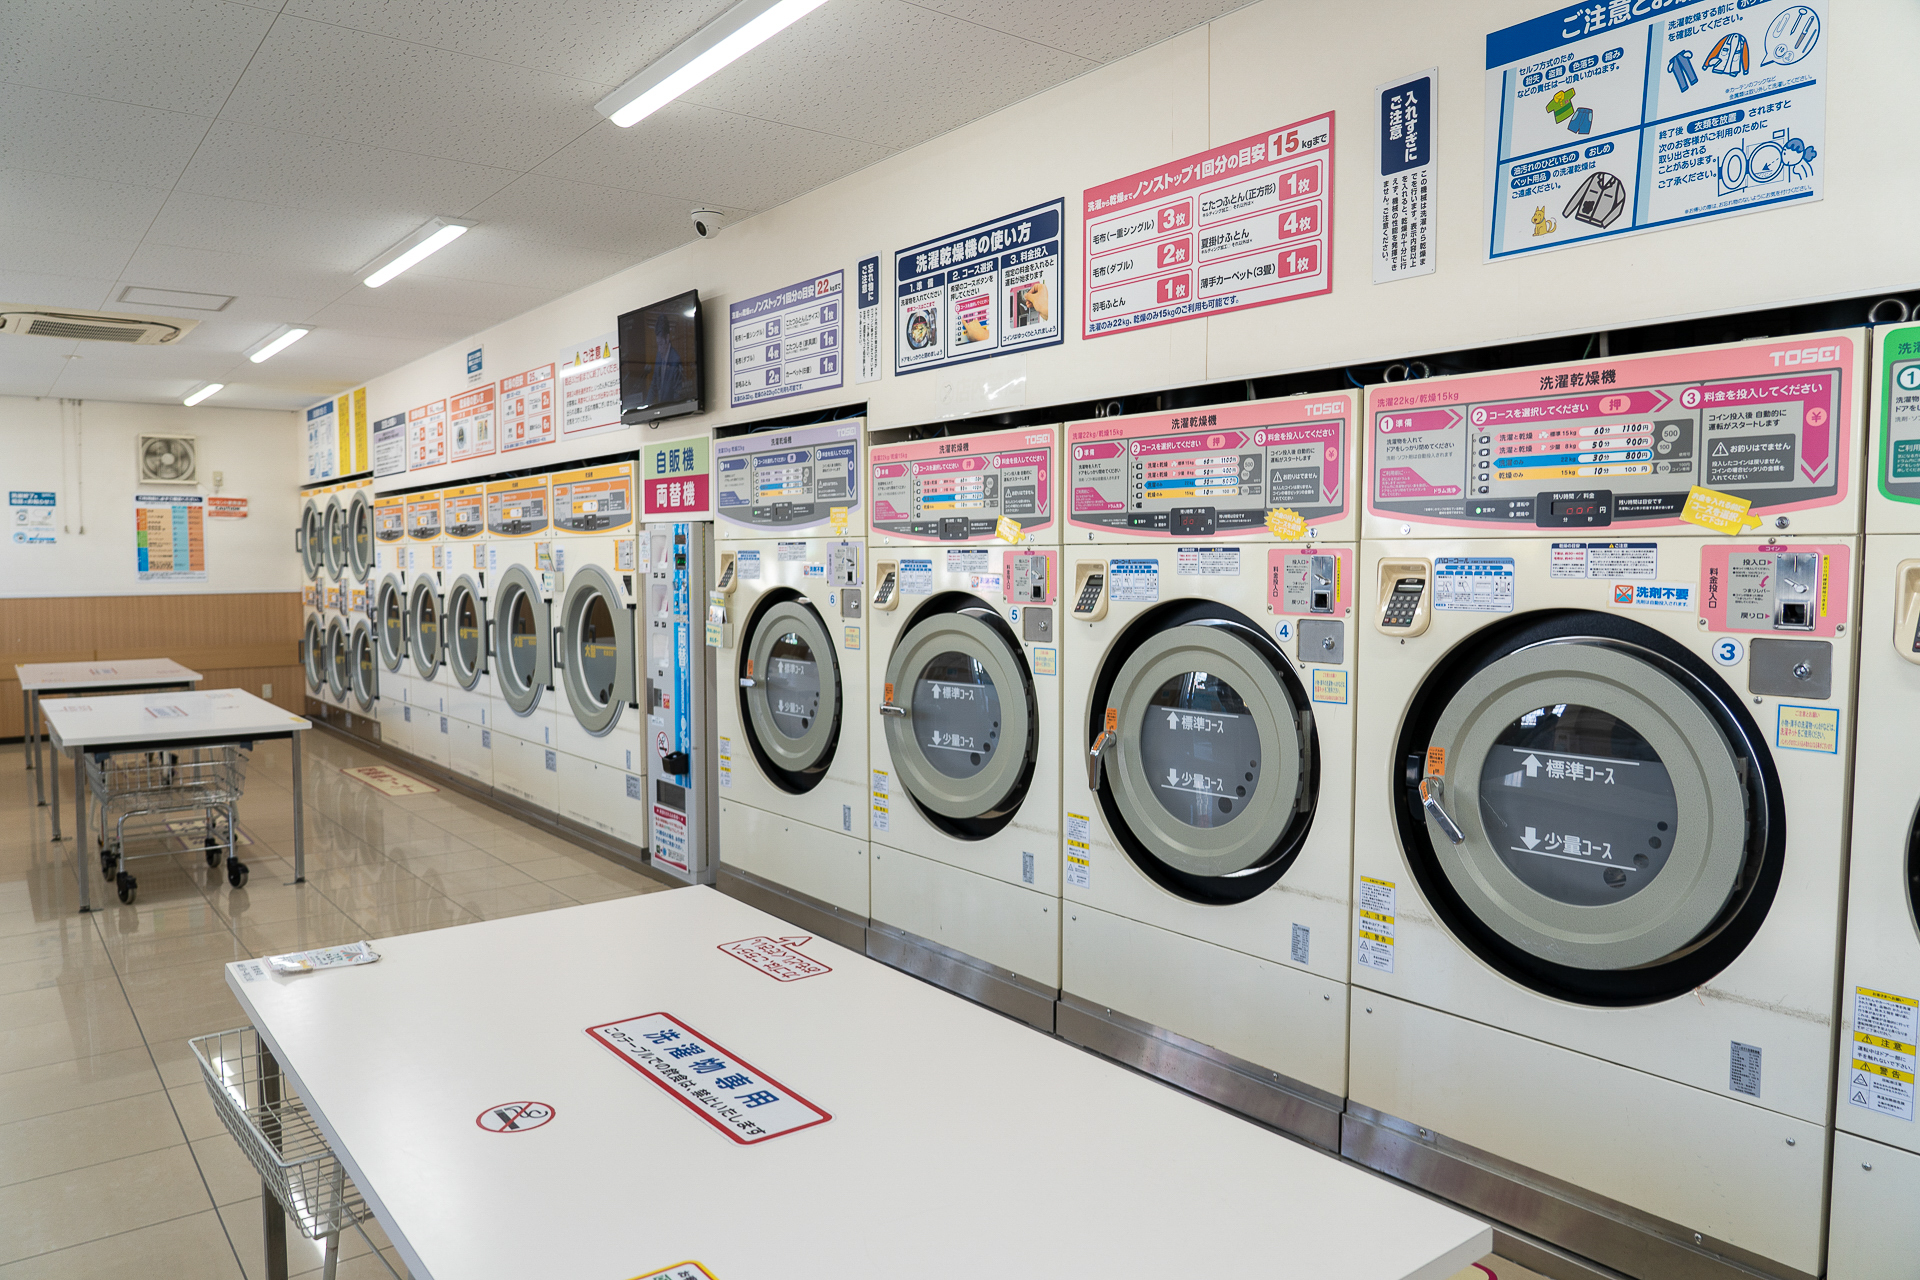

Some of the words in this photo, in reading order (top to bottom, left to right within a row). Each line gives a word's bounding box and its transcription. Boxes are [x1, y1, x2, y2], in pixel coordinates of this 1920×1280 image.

[1668, 3, 1734, 30] 洗濯乾燥する前に
[1668, 15, 1744, 41] を確認してください。
[1519, 52, 1574, 75] セルフ方式のため
[1525, 75, 1540, 86] 紛失
[1548, 67, 1563, 79] 盗難
[1572, 56, 1595, 71] 色落ち
[1606, 51, 1621, 62] 縮み
[1517, 64, 1620, 98] などの責任は一切負いかねます。
[1390, 95, 1402, 140] ご注意
[1659, 126, 1683, 140] 終了後
[1694, 113, 1736, 132] 衣類を放置
[1749, 100, 1791, 118] されますと
[1405, 91, 1418, 162] 入れすぎに
[1272, 131, 1299, 156] 15
[1302, 133, 1327, 149] kgまで
[1659, 120, 1767, 153] 次のお客様がご利用のために
[1513, 153, 1576, 176] 油汚れのひどいもの
[1588, 144, 1611, 156] おしめ
[1659, 145, 1706, 164] 取り出される
[1659, 156, 1716, 174] ことがあります。
[1513, 173, 1547, 186] ペット用品
[1553, 161, 1596, 178] の洗濯乾燥は
[1658, 170, 1716, 189] ご了承ください。
[1202, 183, 1276, 212] こたつふとん（正方形）
[1287, 174, 1310, 195] 1枚
[1511, 183, 1561, 199] ご遠慮ください。
[1163, 209, 1185, 229] 3枚
[1201, 229, 1249, 250] 夏掛けふとん
[1283, 212, 1311, 234] 4枚
[916, 222, 1031, 273] 洗濯乾燥機の使い方
[1020, 246, 1048, 261] 料金投入
[1005, 259, 1055, 278] 指定の料金を入れると
[1093, 260, 1133, 277] 毛布（ダブル）
[1163, 244, 1185, 265] 2枚
[1287, 252, 1308, 273] 1枚
[962, 261, 993, 278] コース選択
[951, 275, 993, 292] 希望のコースボタンを
[1005, 270, 1044, 287] 運転が始まります
[817, 279, 829, 295] 22
[951, 287, 980, 301] 押してください
[901, 290, 942, 306] 洗濯物を入れてください
[1093, 298, 1125, 313] 羽毛ふとん
[1165, 280, 1185, 298] 1枚
[824, 307, 834, 321] 1枚
[768, 322, 779, 335] 5枚
[824, 332, 834, 346] 1枚
[583, 346, 601, 363] ご注意
[768, 346, 779, 359] 4枚
[1769, 345, 1840, 366] TOSEI
[823, 358, 833, 372] 1枚
[768, 371, 779, 384] 2枚
[1540, 369, 1616, 391] 洗濯乾燥機
[1377, 392, 1459, 408] 洗濯22kg/乾燥15kg
[1704, 383, 1823, 402] 料金を投入してください
[1305, 402, 1344, 416] TOSEI
[1490, 403, 1589, 420] コースを選択してください
[1609, 398, 1622, 410] 押
[1709, 411, 1752, 422] コイン投入後
[1756, 409, 1787, 418] 自動的に
[1172, 415, 1217, 430] 洗濯乾燥機
[1396, 420, 1412, 428] 準備
[1709, 419, 1780, 431] 運転がスタートします
[837, 427, 856, 437] TOSEI
[1025, 434, 1050, 445] TOSEI
[1268, 429, 1335, 441] 料金を投入してください
[1499, 432, 1533, 441] 洗濯と乾燥
[1594, 427, 1610, 435] 60分
[1664, 429, 1678, 438] 500
[939, 443, 969, 454] 洗濯乾燥機
[1141, 440, 1201, 451] コースを選択してください
[1386, 436, 1423, 445] 洗濯物を入れて
[1386, 442, 1455, 453] ドアをしっかり閉めてください
[1499, 444, 1533, 454] 洗濯と乾燥
[1592, 440, 1610, 449] 50分
[1626, 438, 1649, 447] 900円
[1730, 443, 1791, 453] お釣りはでません
[656, 447, 694, 474] 自販機
[1002, 455, 1045, 465] 料金を投入してください
[1499, 458, 1524, 467] 洗濯のみ
[1593, 454, 1609, 462] 30分
[1625, 451, 1648, 460] 800円
[1712, 458, 1781, 467] 投入したコインは戻りません
[1499, 471, 1524, 480] 乾燥のみ
[1594, 467, 1609, 475] 10分
[1711, 473, 1748, 481] 入れてください
[656, 481, 695, 509] 両替機
[1691, 492, 1745, 513] お金を入れる前に
[1695, 513, 1728, 526] して下さい
[1636, 586, 1689, 600] 洗剤不要
[1709, 568, 1718, 609] 料金投入口
[830, 594, 835, 604] 6
[1012, 610, 1017, 620] 5
[1279, 625, 1289, 638] 4
[1719, 643, 1735, 661] 3
[942, 686, 975, 701] 標準コース
[784, 702, 805, 714] 少量コース
[1182, 716, 1224, 734] 標準コース
[942, 733, 975, 748] 少量コース
[1546, 759, 1615, 785] 標準コース
[1181, 771, 1224, 792] 少量コース
[1544, 832, 1612, 860] 少量コース
[1881, 1039, 1902, 1051] 注意
[1858, 1046, 1906, 1062] 運転中はドアー部に
[643, 1029, 779, 1109] 洗濯物専用
[1880, 1067, 1901, 1079] 警告
[604, 1027, 767, 1137] このテーブルでの飲食は、禁止いたします
